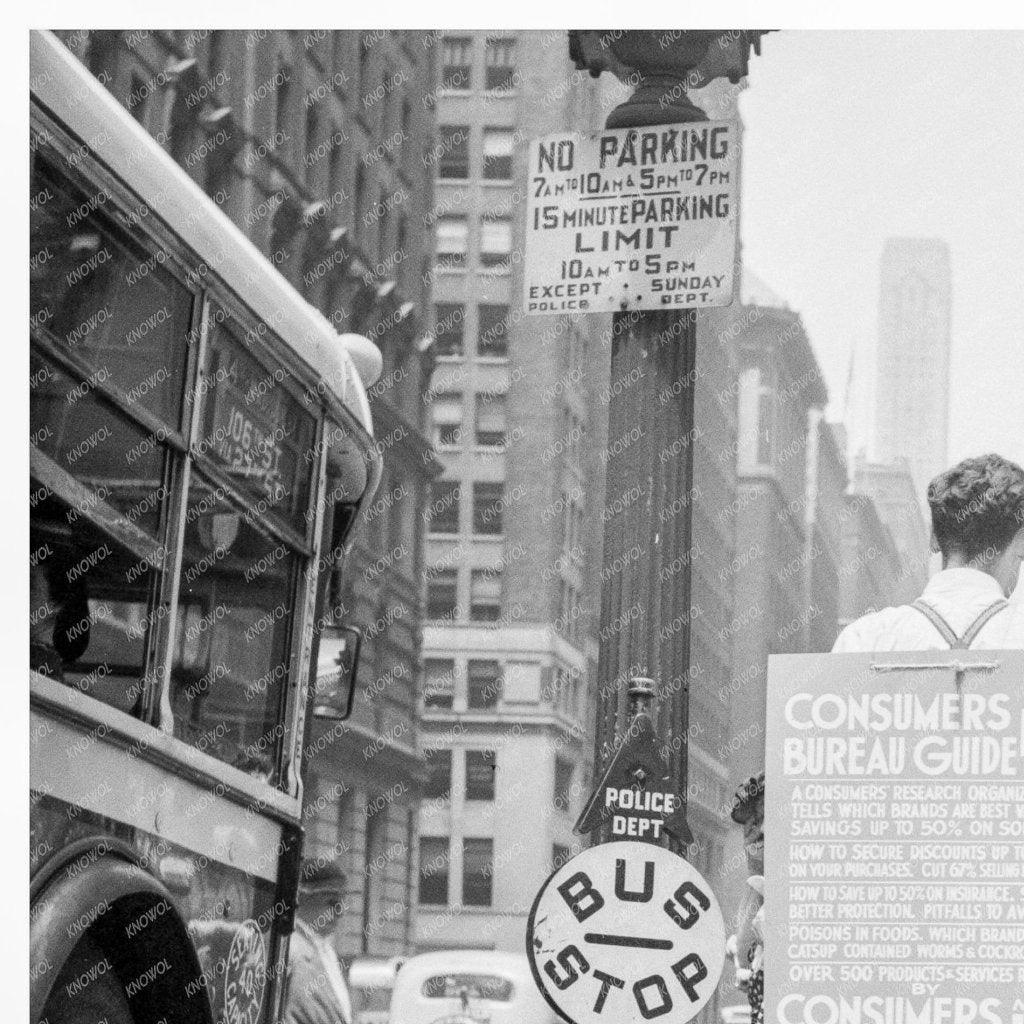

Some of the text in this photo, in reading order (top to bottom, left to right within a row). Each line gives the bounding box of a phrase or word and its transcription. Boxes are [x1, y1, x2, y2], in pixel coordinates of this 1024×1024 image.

[538, 126, 729, 173] NO PARKING
[533, 206, 559, 230] 15
[631, 193, 729, 224] PARKING
[575, 225, 679, 253] LIMIT
[529, 275, 725, 299] EXCEPT SUNDAY
[784, 692, 1012, 731] CONSUMERS
[783, 735, 1017, 776] BUREAU GUIDE
[605, 787, 675, 814] POLICE
[791, 784, 803, 801] A
[893, 785, 962, 802] RESEARCH
[791, 803, 832, 819] TELLS
[838, 803, 887, 818] WHICH
[891, 803, 948, 819] BRANDS
[952, 803, 976, 819] ARE
[980, 803, 1011, 819] BEST
[612, 815, 664, 838] DEPT
[791, 820, 862, 836] SAVINGS
[870, 821, 890, 836] UP
[895, 821, 914, 836] TO
[920, 820, 963, 836] 50%
[969, 821, 994, 836] ON
[789, 844, 825, 861] HOW
[829, 845, 848, 860] TO
[852, 844, 904, 860] SECURE
[910, 844, 986, 861] DISCOUNTS
[991, 845, 1010, 861] UP
[788, 862, 807, 877] ON
[810, 862, 842, 877] YOUR
[921, 862, 946, 878] CUT
[949, 863, 977, 879] 67%
[979, 863, 1020, 878] SELLING
[556, 858, 711, 931] BUS
[789, 886, 819, 901] HOW
[823, 886, 838, 901] TO
[838, 886, 865, 901] SAVE
[868, 886, 883, 901] UP
[884, 886, 898, 901] TO
[899, 886, 925, 901] 50%
[926, 886, 944, 902] ON
[789, 904, 834, 919] BETTER
[838, 904, 915, 919] PROTECTION.
[924, 904, 981, 919] PITFALLS
[987, 904, 1003, 920] TO
[789, 926, 851, 941] POISONS
[855, 927, 869, 941] IN
[872, 927, 923, 942] FOODS.
[929, 927, 976, 942] WHICH
[788, 944, 838, 959] CATSUP
[844, 944, 912, 959] CONTAINED
[917, 944, 964, 959] WORMS
[966, 947, 977, 959] &
[543, 944, 708, 1021] STOP
[789, 965, 835, 982] OVER
[840, 966, 873, 982] 500
[911, 983, 940, 996] BY
